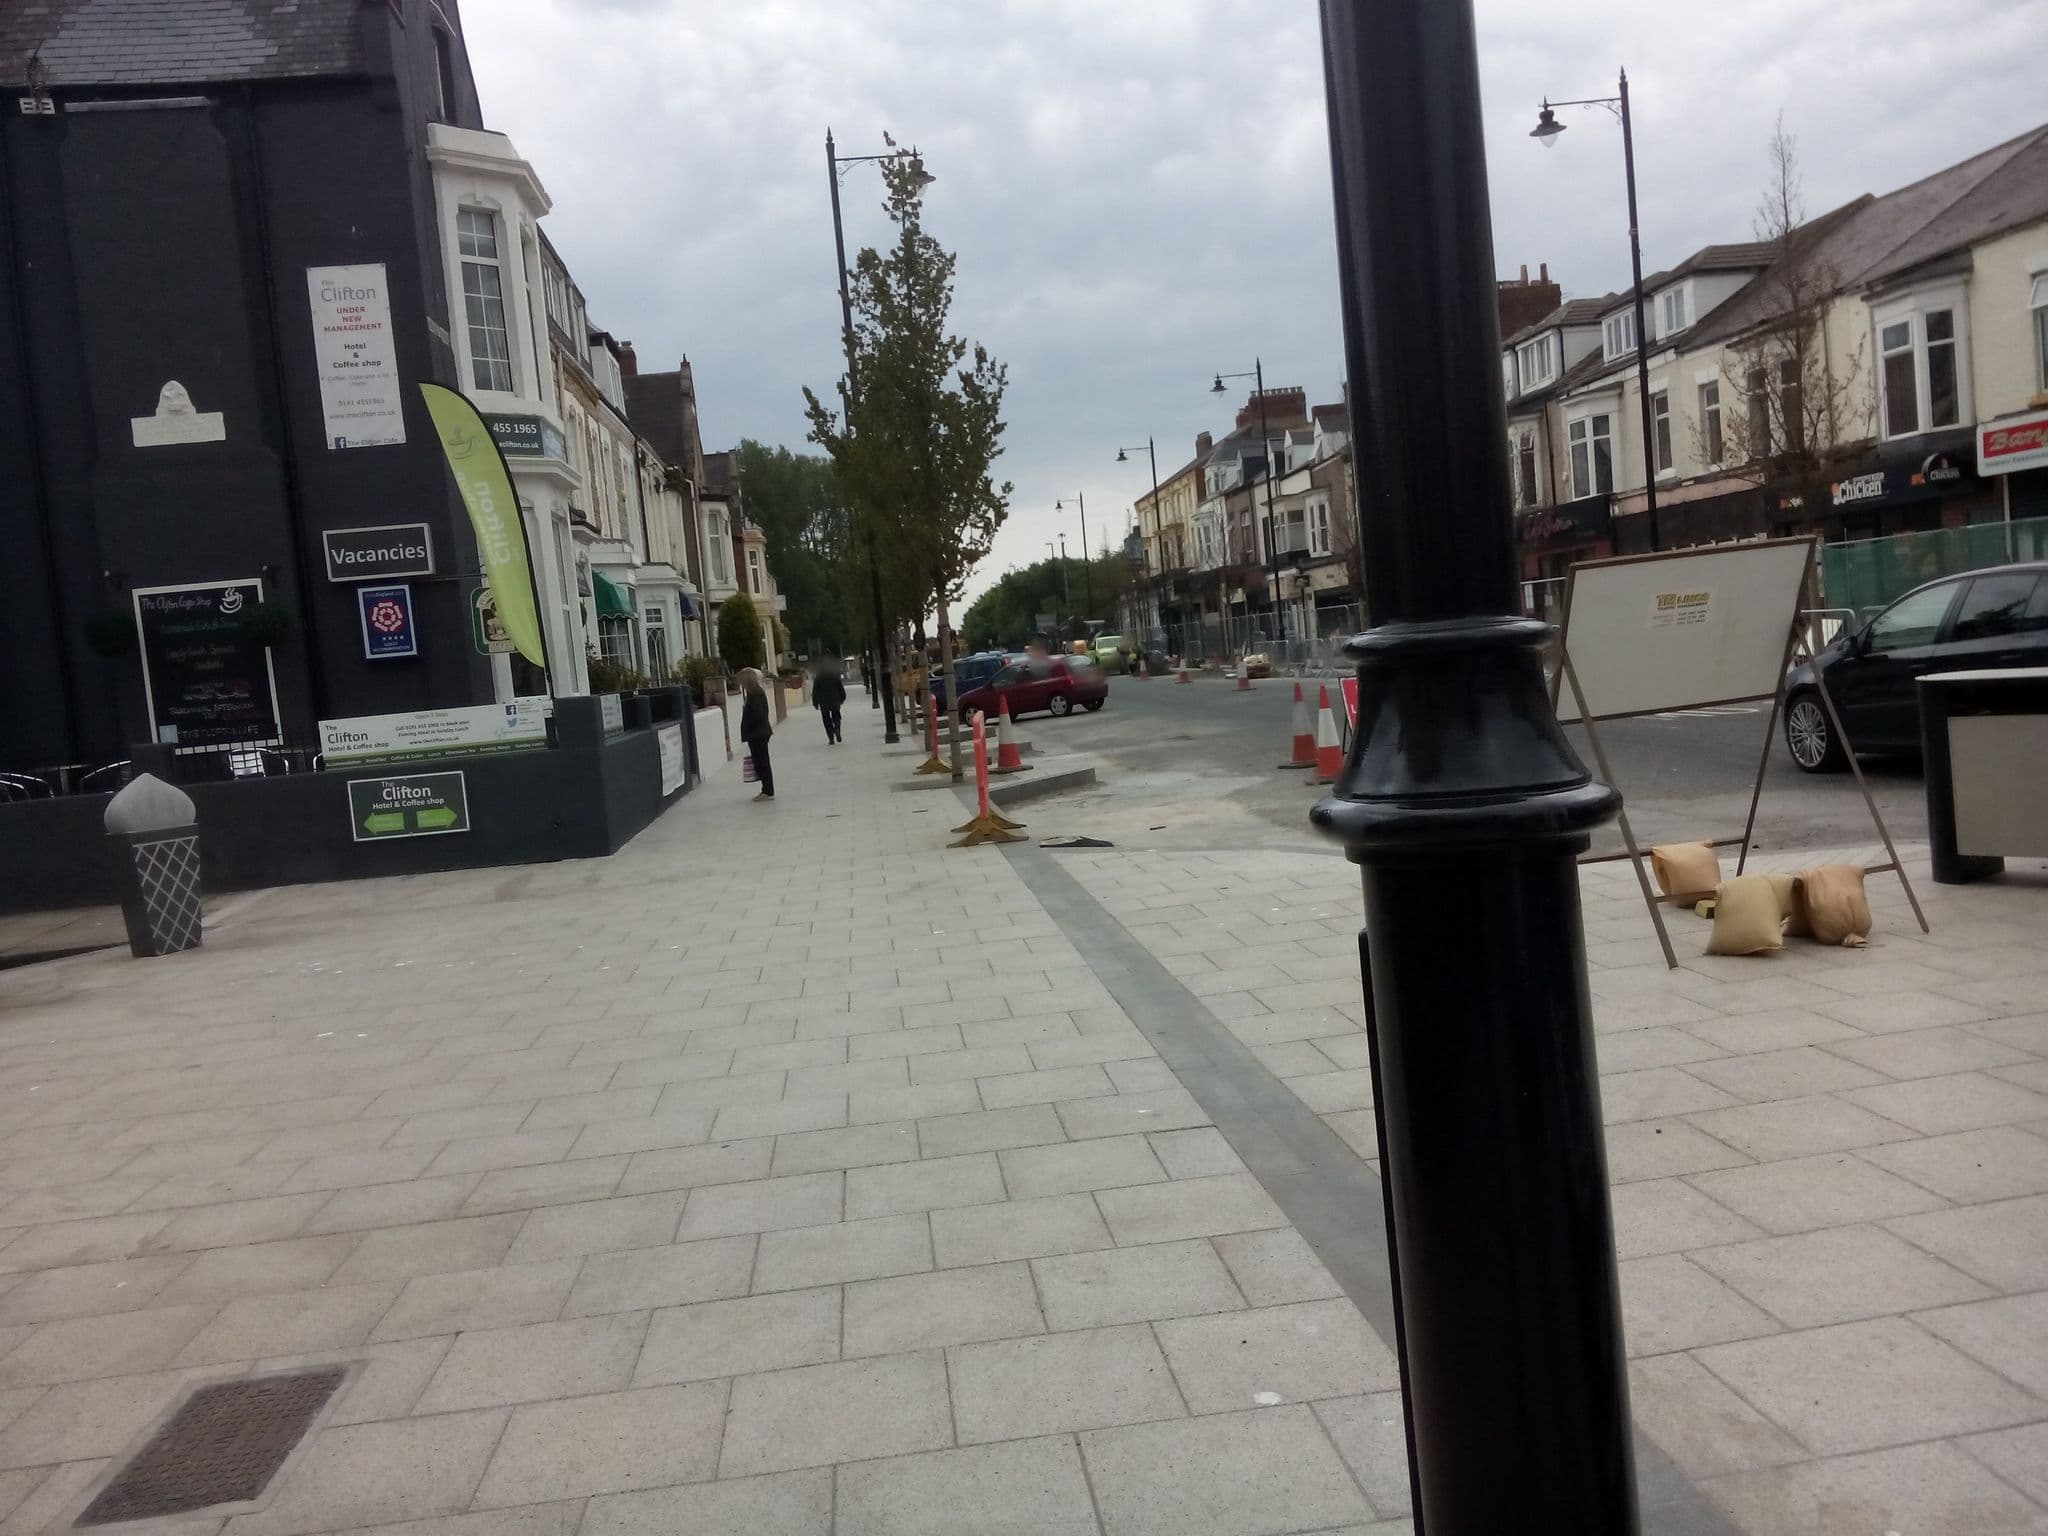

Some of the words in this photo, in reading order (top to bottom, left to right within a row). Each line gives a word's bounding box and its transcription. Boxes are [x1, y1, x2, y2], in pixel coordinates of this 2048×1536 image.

[321, 287, 376, 302] Clifton
[336, 306, 366, 314] UNDER
[342, 315, 362, 323] NEW
[323, 322, 383, 332] MANAGEMENT
[344, 342, 367, 350] Hotel
[333, 361, 359, 369] Coffee
[362, 359, 382, 367] shop
[493, 423, 511, 433] 455
[513, 424, 537, 434] 1965
[1839, 480, 1883, 501] Chicken
[331, 543, 426, 565] Vacancies
[327, 732, 369, 744] Clifton
[382, 786, 431, 800] Clifton
[372, 801, 392, 809] Hotel
[402, 799, 425, 807] Coffee
